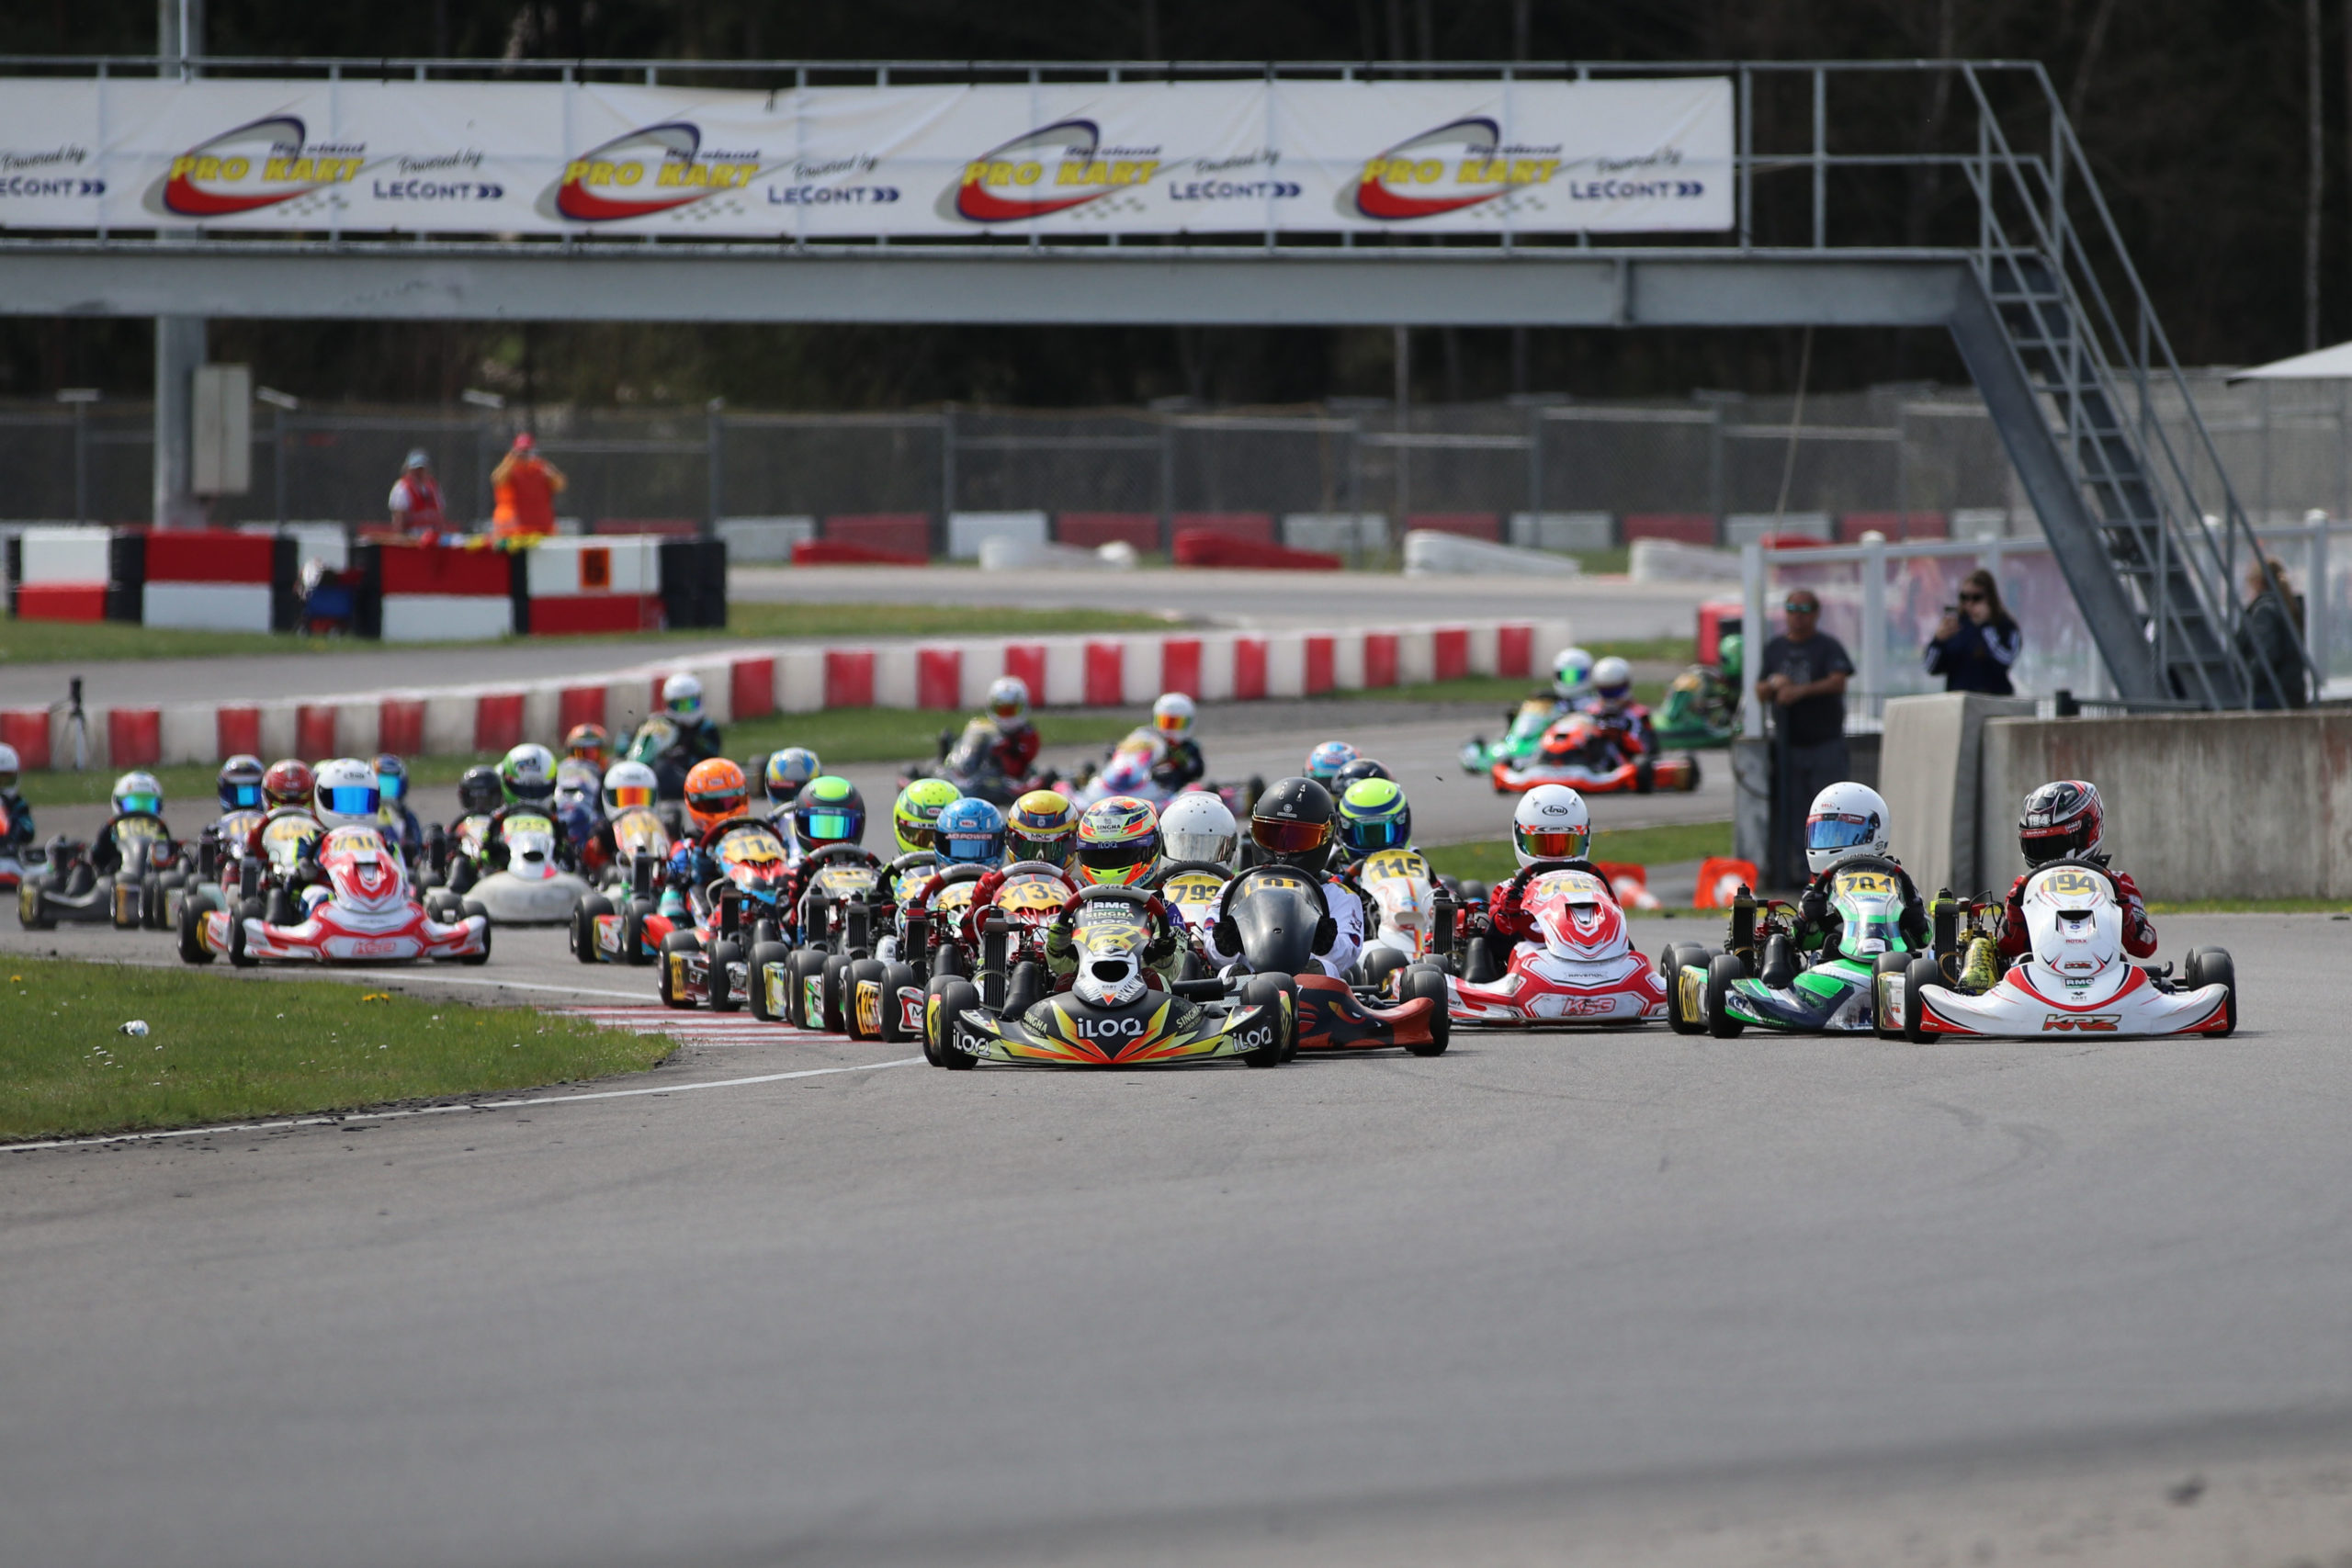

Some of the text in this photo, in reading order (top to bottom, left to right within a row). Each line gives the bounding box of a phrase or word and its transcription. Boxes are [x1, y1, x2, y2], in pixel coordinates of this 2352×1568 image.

[169, 155, 365, 182] PRO KART
[562, 161, 760, 188] PRO KART
[962, 160, 1159, 186] PRO KART
[1361, 158, 1561, 184] PRO KART
[0, 175, 72, 197] CONT
[2027, 814, 2051, 827] 194
[1371, 858, 1424, 878] 115
[1012, 883, 1069, 902] 135
[1170, 885, 1221, 903] 793
[2047, 874, 2098, 892] 194
[1023, 1010, 1048, 1032] SINGHA
[1077, 1017, 1145, 1038] iLOQ
[953, 1029, 991, 1056] iLOQ
[1232, 1025, 1273, 1053] iLOQ
